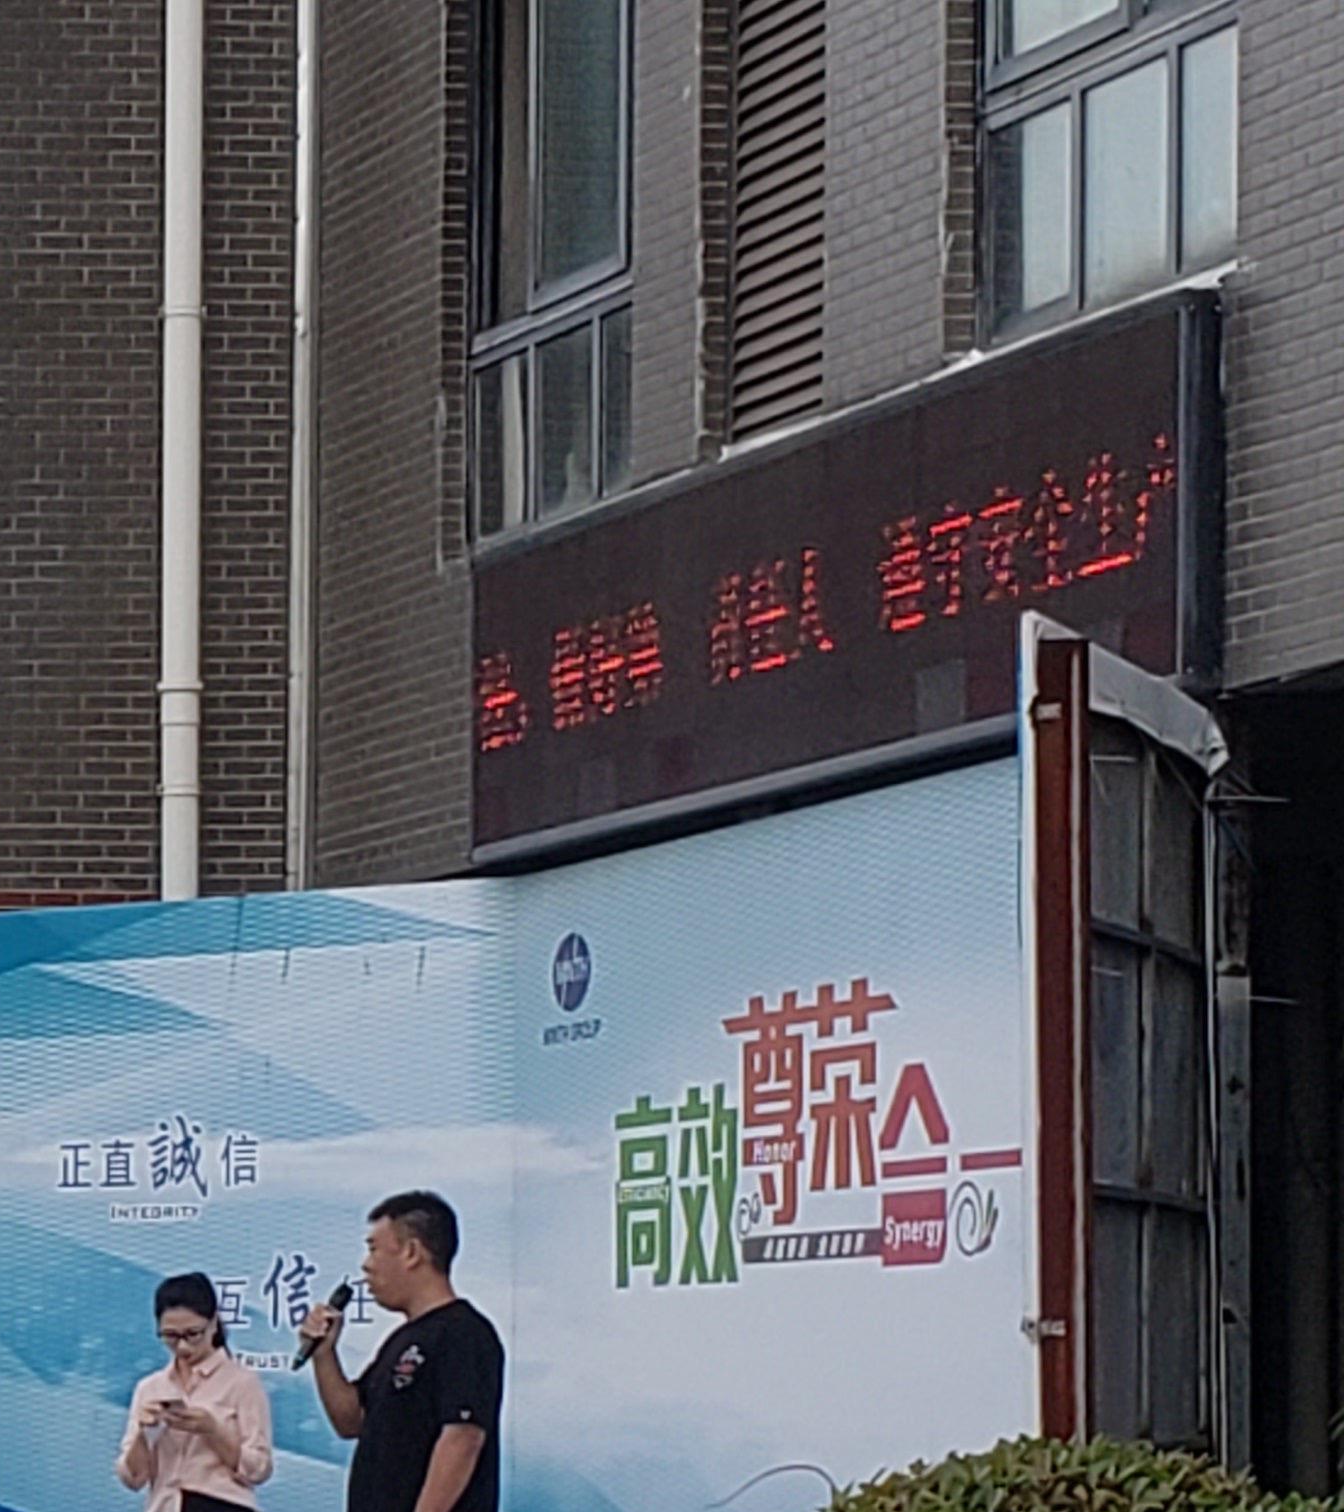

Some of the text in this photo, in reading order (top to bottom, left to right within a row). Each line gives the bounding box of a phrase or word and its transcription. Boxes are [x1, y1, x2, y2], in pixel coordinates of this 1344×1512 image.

[57, 1115, 260, 1198] 正直誠信
[753, 1138, 797, 1163] Honor
[615, 1082, 740, 1289] 高效
[111, 1205, 200, 1220] INTEGRITY
[883, 1215, 945, 1251] Synergy
[235, 1354, 290, 1369] TRUST
